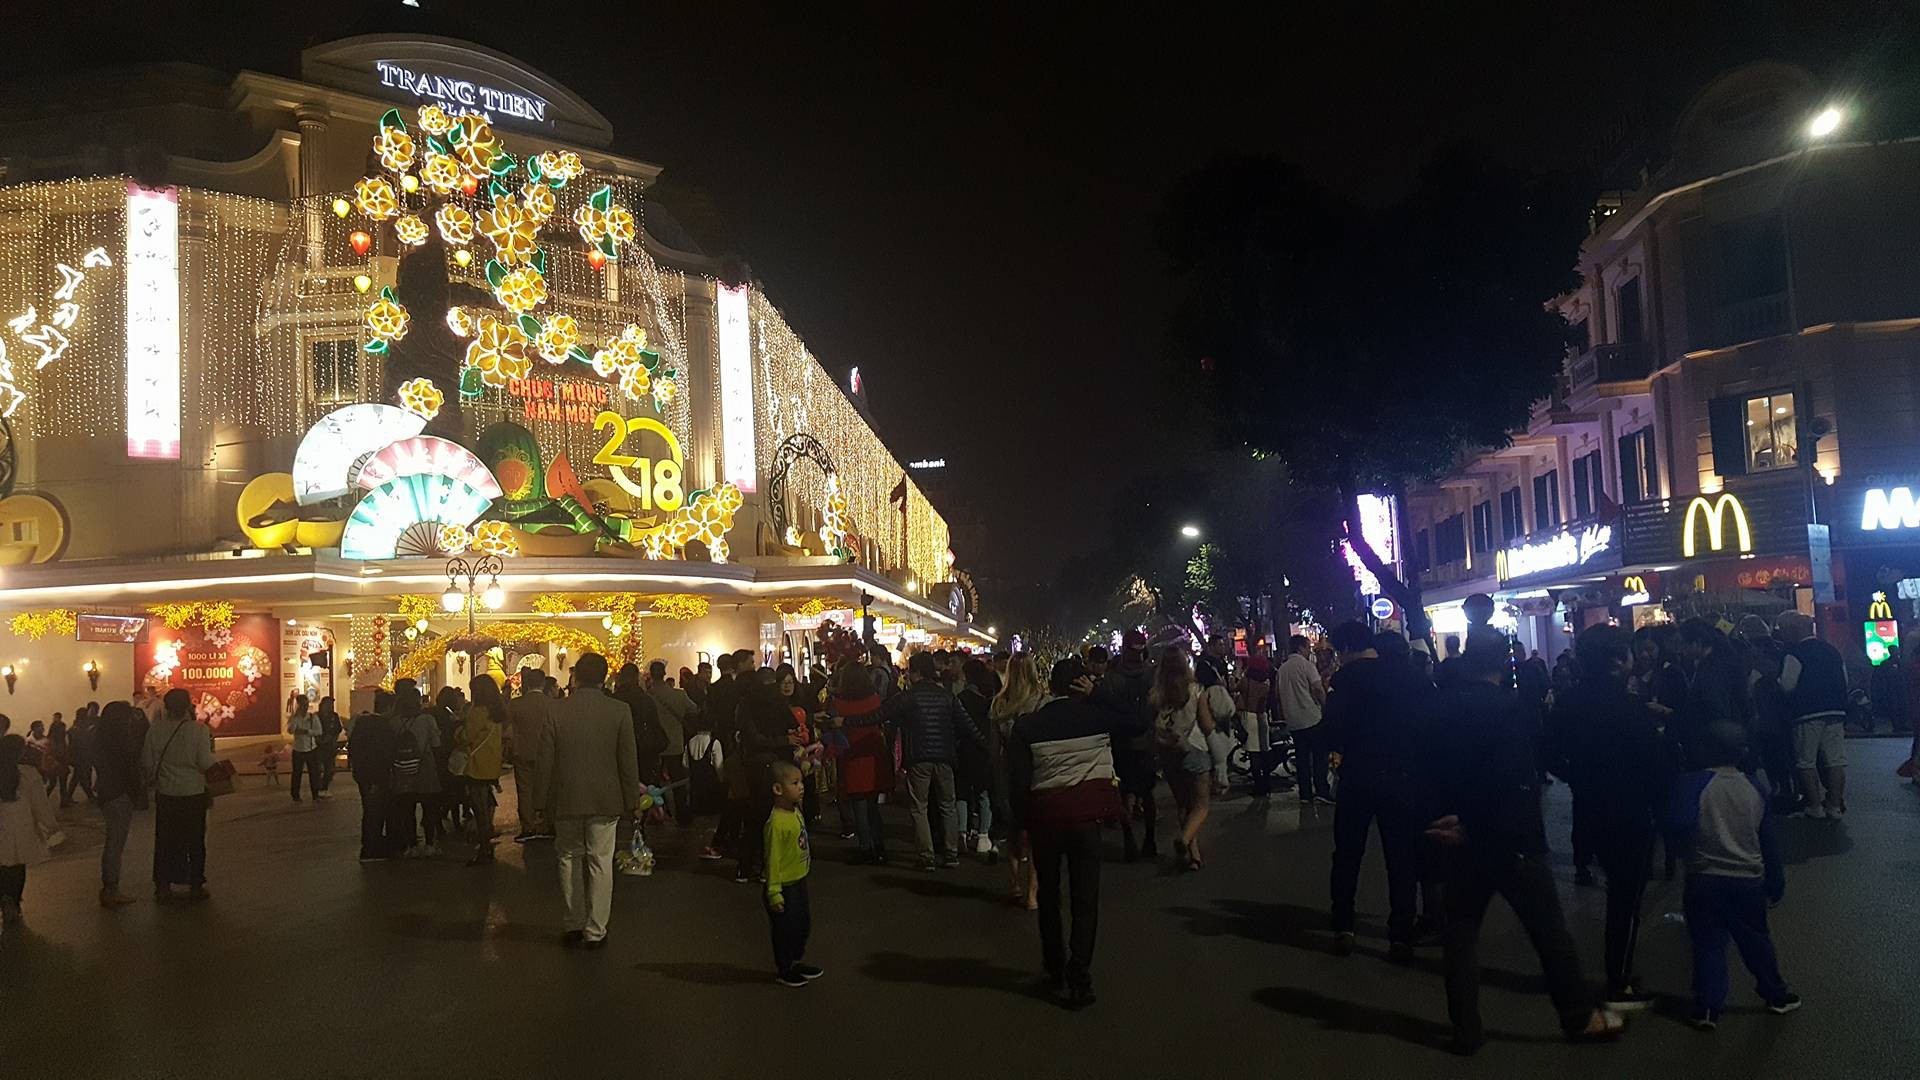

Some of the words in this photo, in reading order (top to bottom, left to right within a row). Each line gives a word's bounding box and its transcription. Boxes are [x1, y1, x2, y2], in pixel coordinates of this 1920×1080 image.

[377, 61, 476, 106] TRANG
[479, 86, 546, 122] TIEN
[592, 411, 684, 512] 2018
[909, 458, 946, 468] ombank
